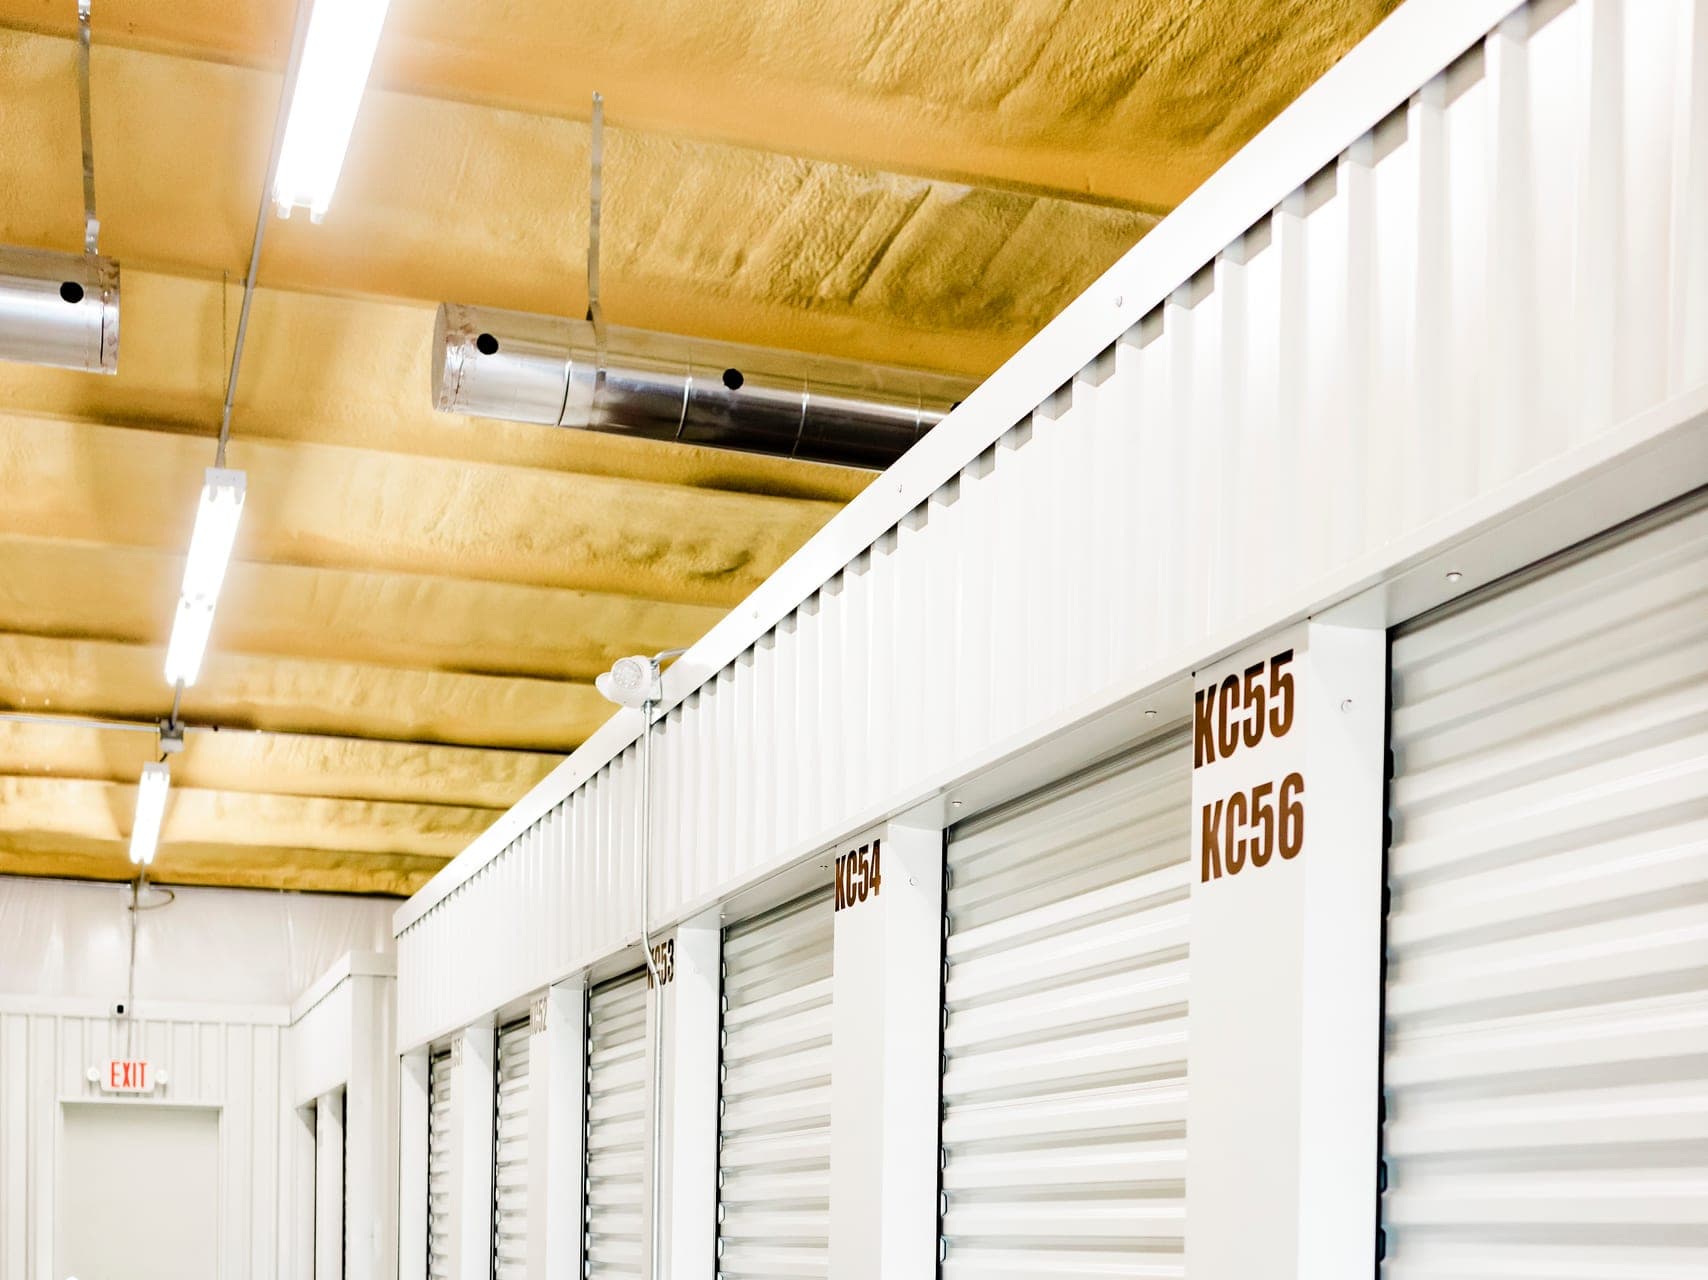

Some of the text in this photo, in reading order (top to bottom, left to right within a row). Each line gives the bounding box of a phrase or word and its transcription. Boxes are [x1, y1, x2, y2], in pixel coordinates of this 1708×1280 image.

[1194, 648, 1294, 769] KC55
[1201, 772, 1304, 883] KC56
[834, 838, 881, 912] KC54
[111, 1061, 147, 1088] EXIT
